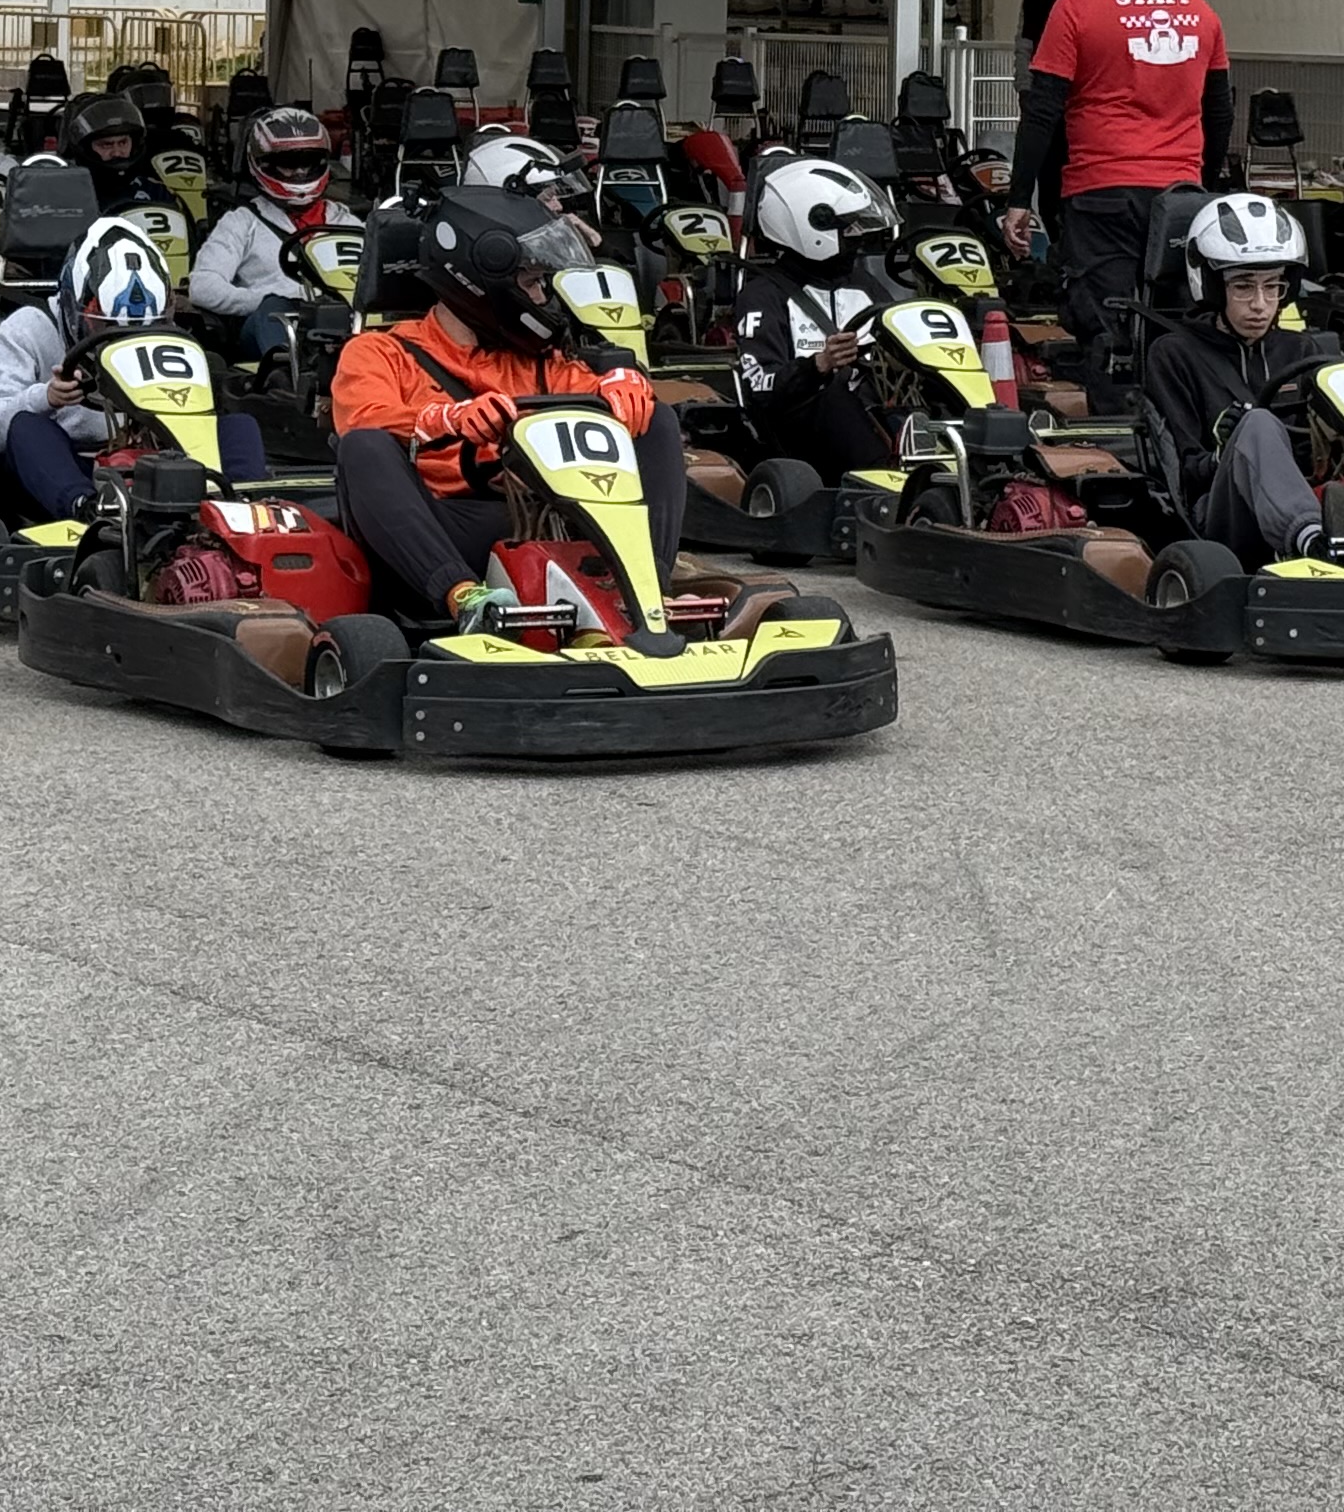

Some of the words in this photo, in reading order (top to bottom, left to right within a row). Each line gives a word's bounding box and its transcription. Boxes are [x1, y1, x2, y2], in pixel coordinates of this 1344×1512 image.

[162, 155, 203, 176] 25
[143, 212, 171, 234] 3
[678, 213, 728, 238] 27
[930, 242, 986, 269] 26
[597, 271, 612, 300] 1
[920, 309, 958, 339] 9
[135, 345, 194, 382] 16
[554, 421, 621, 463] 10
